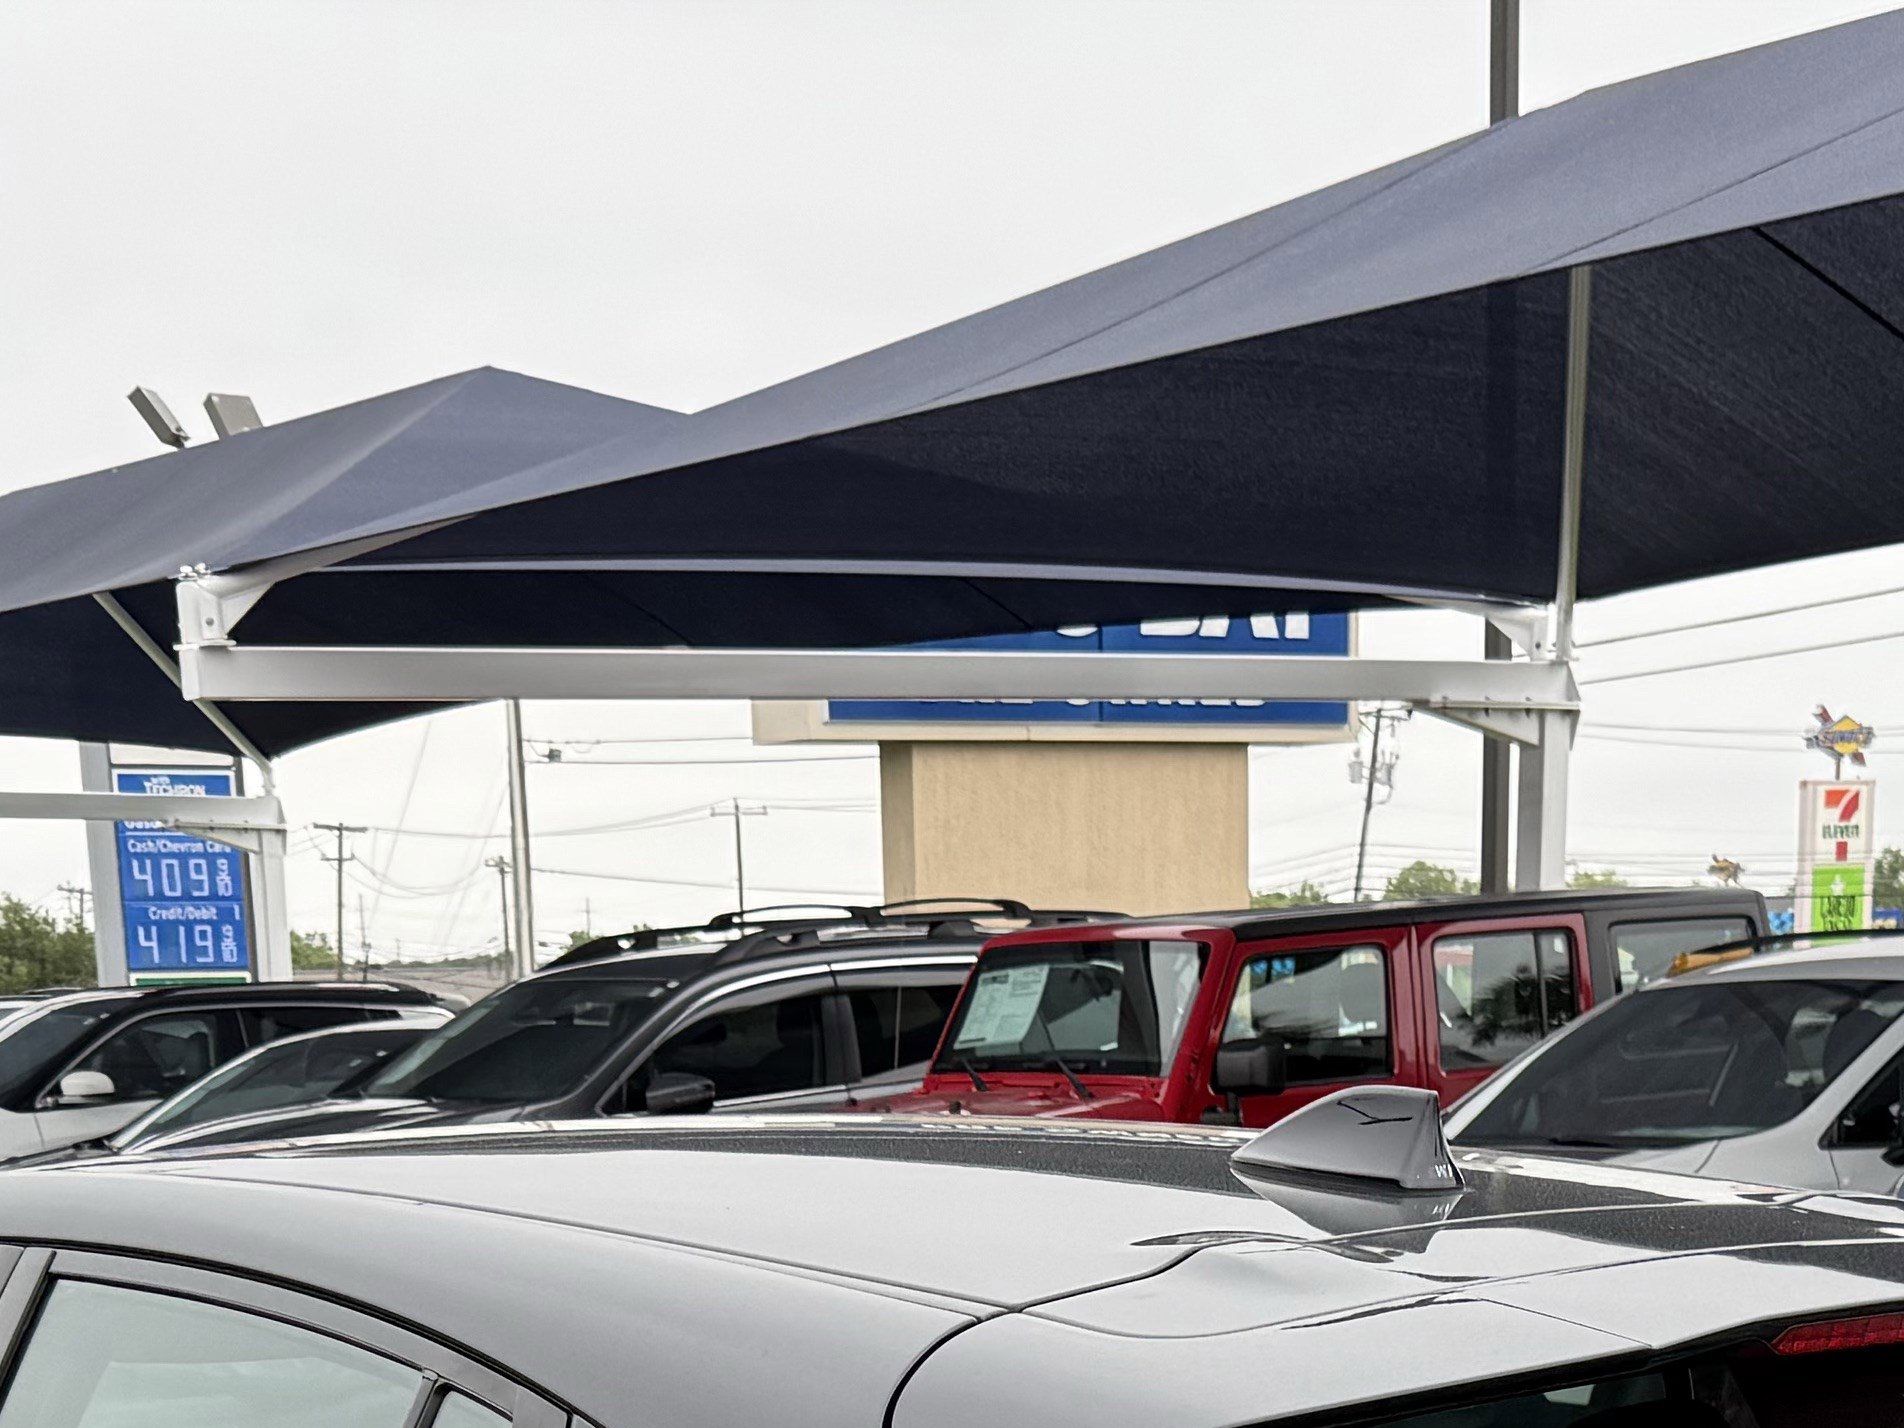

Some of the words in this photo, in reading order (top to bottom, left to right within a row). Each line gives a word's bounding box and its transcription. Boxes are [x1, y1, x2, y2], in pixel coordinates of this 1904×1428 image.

[1824, 790, 1860, 822] 7
[131, 858, 210, 897] 409
[148, 906, 218, 920] Credit/Debit
[137, 924, 215, 964] 419
